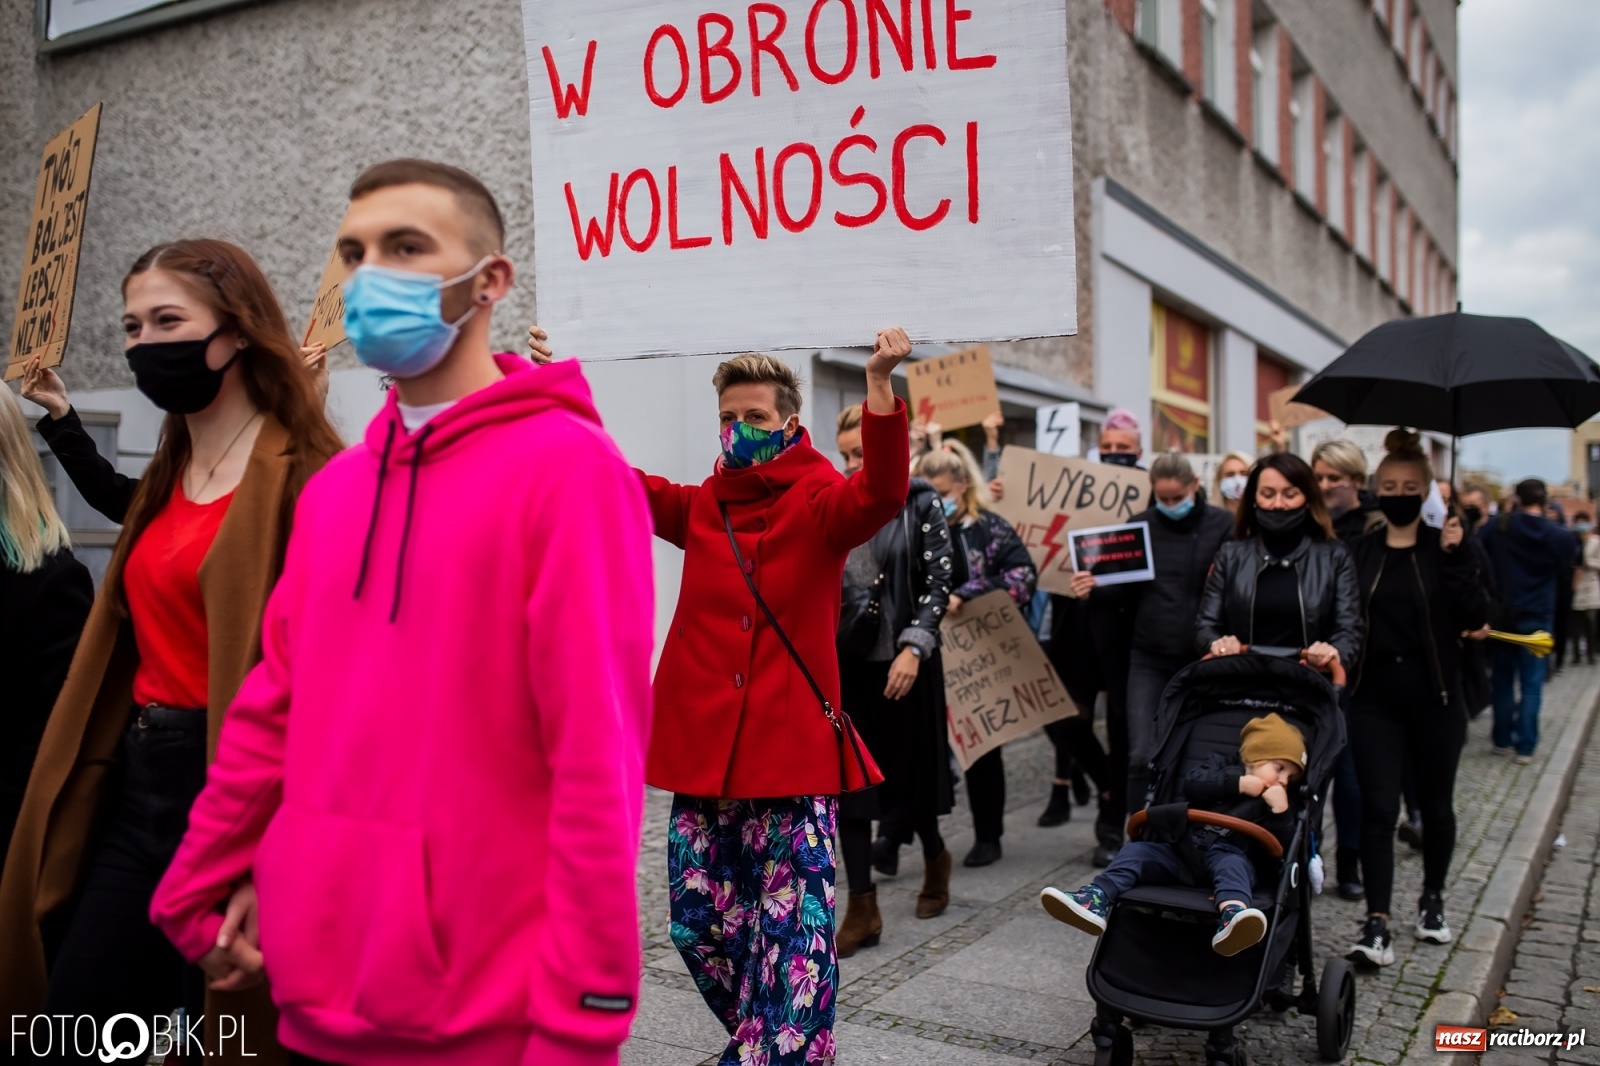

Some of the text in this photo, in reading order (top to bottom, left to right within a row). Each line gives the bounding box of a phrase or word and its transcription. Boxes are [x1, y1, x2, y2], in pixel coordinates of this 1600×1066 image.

[542, 0, 997, 120] W OBRONIE
[41, 130, 81, 210] TWÓJ
[564, 106, 978, 261] WOLNOŚCI
[31, 190, 85, 265] BÓL JEST
[22, 252, 68, 311] LEPSZY
[1027, 462, 1140, 519] WYBÓR
[1012, 663, 1065, 719] NIE!
